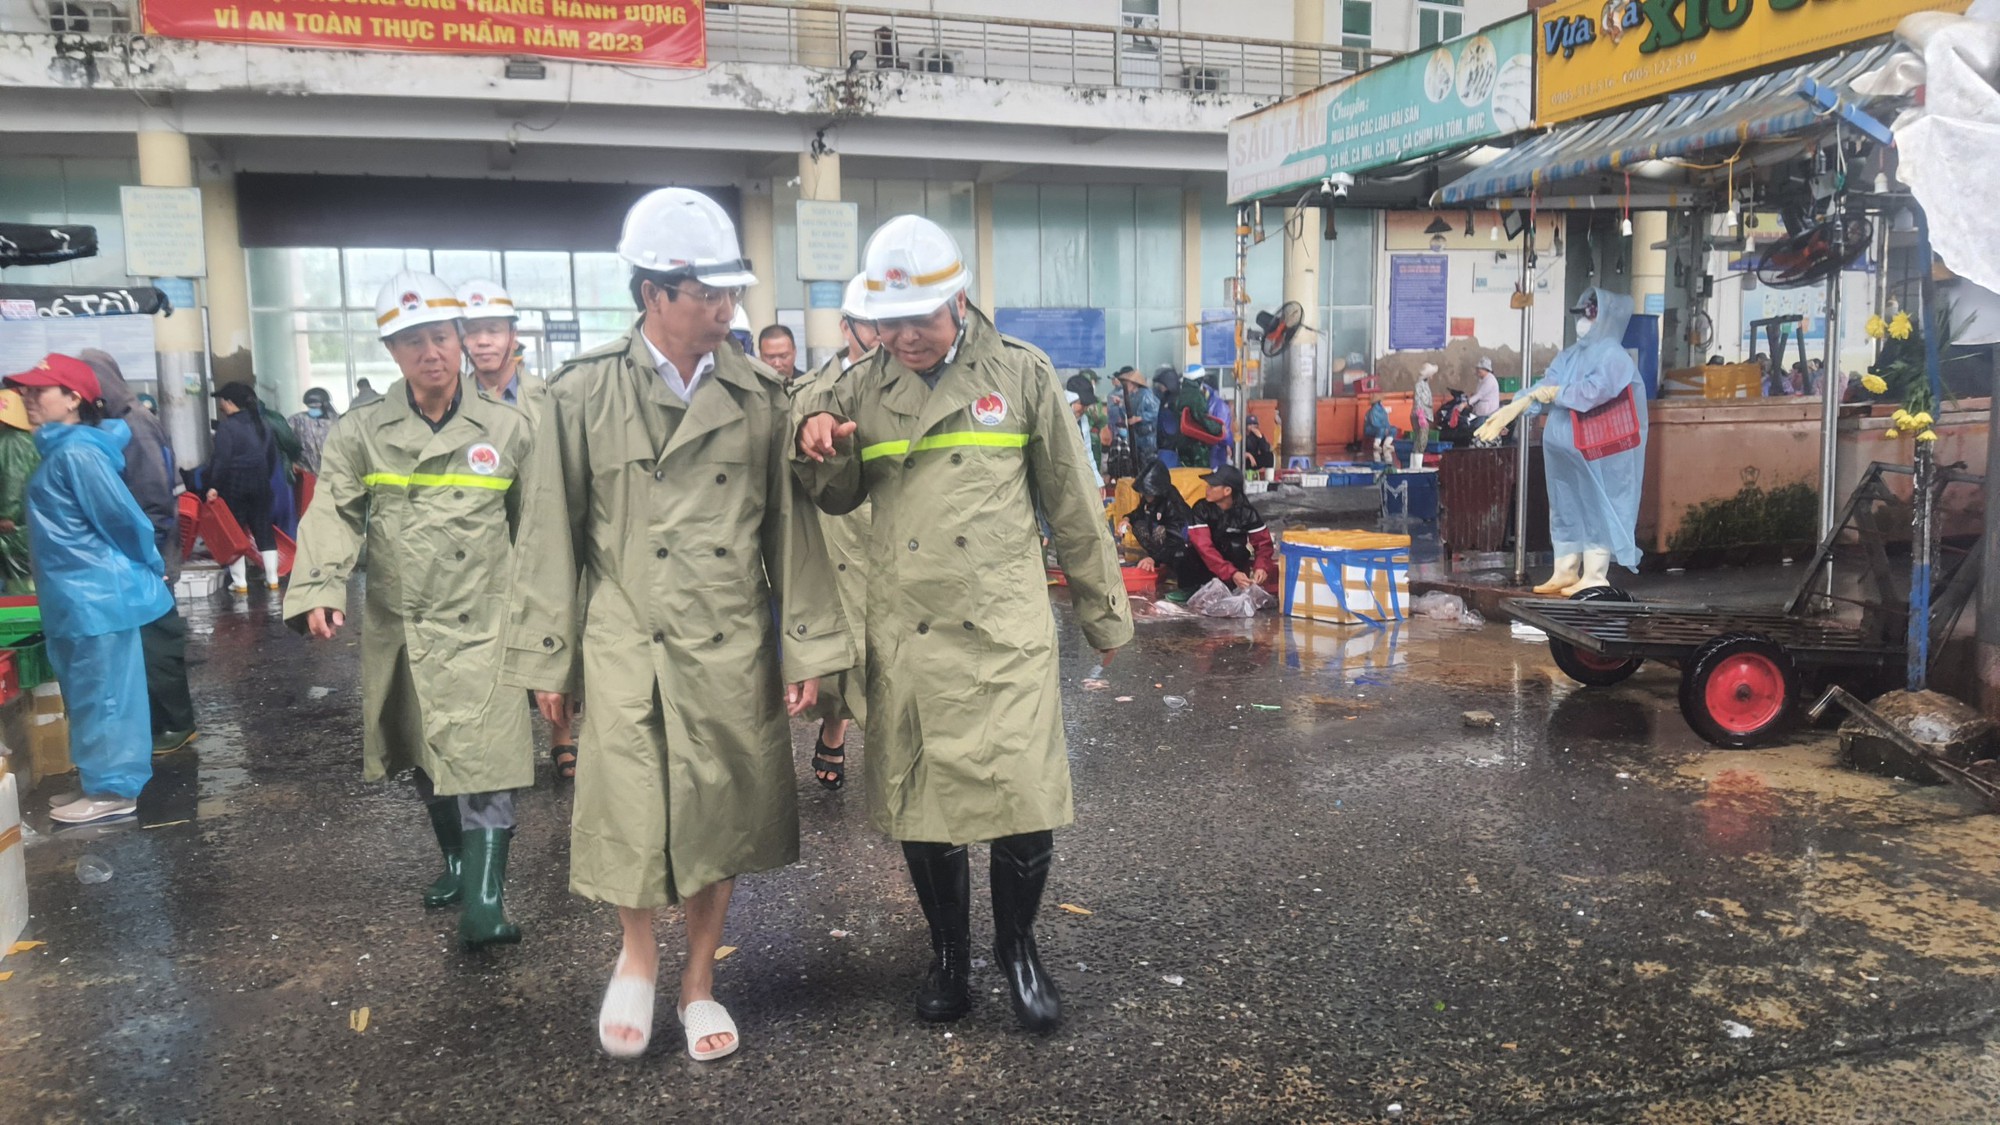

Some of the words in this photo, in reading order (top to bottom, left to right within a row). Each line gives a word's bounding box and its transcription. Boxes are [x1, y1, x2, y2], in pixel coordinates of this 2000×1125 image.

[213, 7, 240, 30] VÌ
[246, 10, 286, 32] AN
[292, 10, 362, 36] TOÀN
[369, 16, 435, 43] THỰC
[443, 17, 516, 46] PHẨM
[523, 24, 580, 49] NĂM
[587, 30, 645, 53] 2023
[1543, 15, 1594, 58] Vựa
[1331, 129, 1345, 145] MUA
[1374, 114, 1390, 133] LOẠI
[1404, 101, 1420, 124] SẢN
[1414, 125, 1433, 147] CHIM
